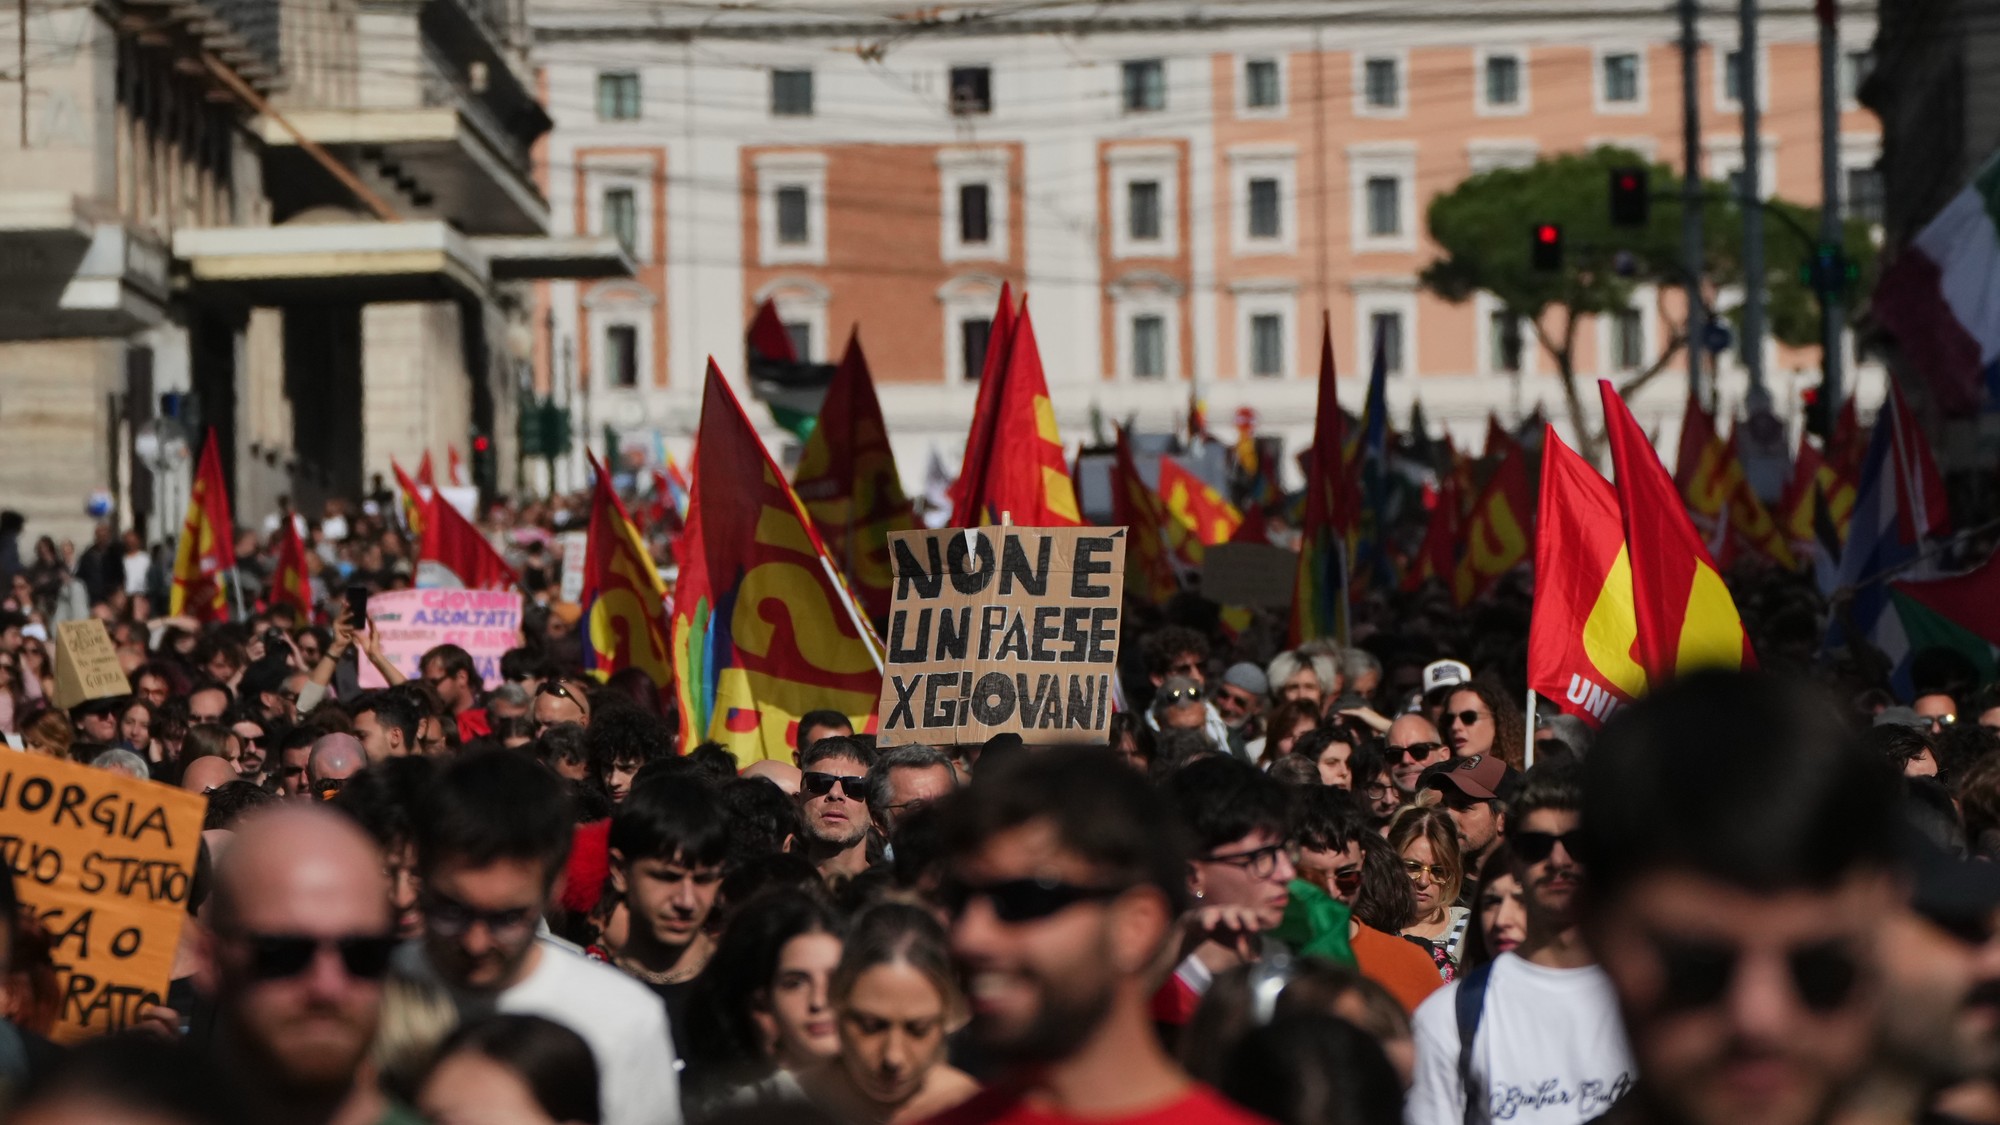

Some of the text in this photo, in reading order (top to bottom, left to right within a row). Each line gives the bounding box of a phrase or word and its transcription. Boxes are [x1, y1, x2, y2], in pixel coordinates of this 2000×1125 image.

[893, 531, 1052, 600] NON
[888, 605, 1118, 664] UN PAESE
[1566, 672, 1622, 723] UNI
[79, 852, 189, 903] STATO
[110, 927, 142, 959] O
